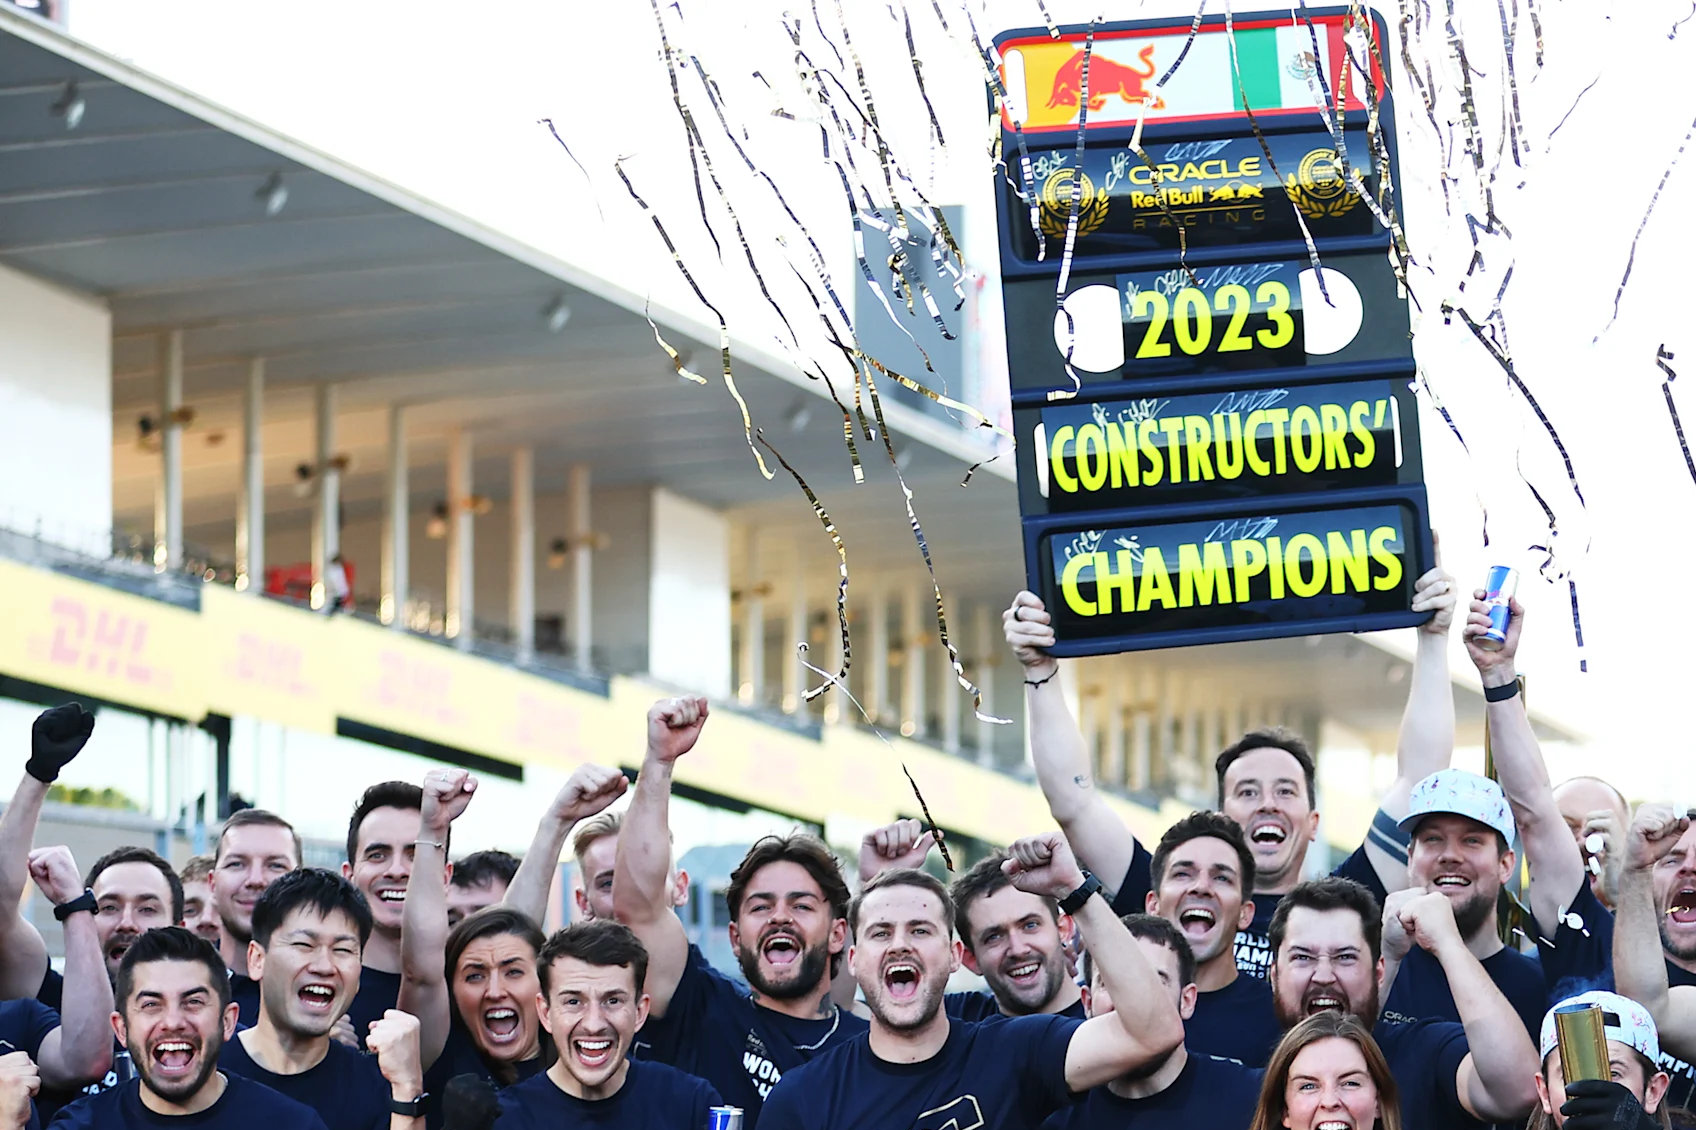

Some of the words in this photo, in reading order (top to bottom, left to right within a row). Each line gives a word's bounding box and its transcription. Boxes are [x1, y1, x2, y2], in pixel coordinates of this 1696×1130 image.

[1131, 280, 1296, 359] 2023
[1050, 399, 1387, 493] CONSTRUCTORS'
[1061, 525, 1403, 617] CHAMPIONS
